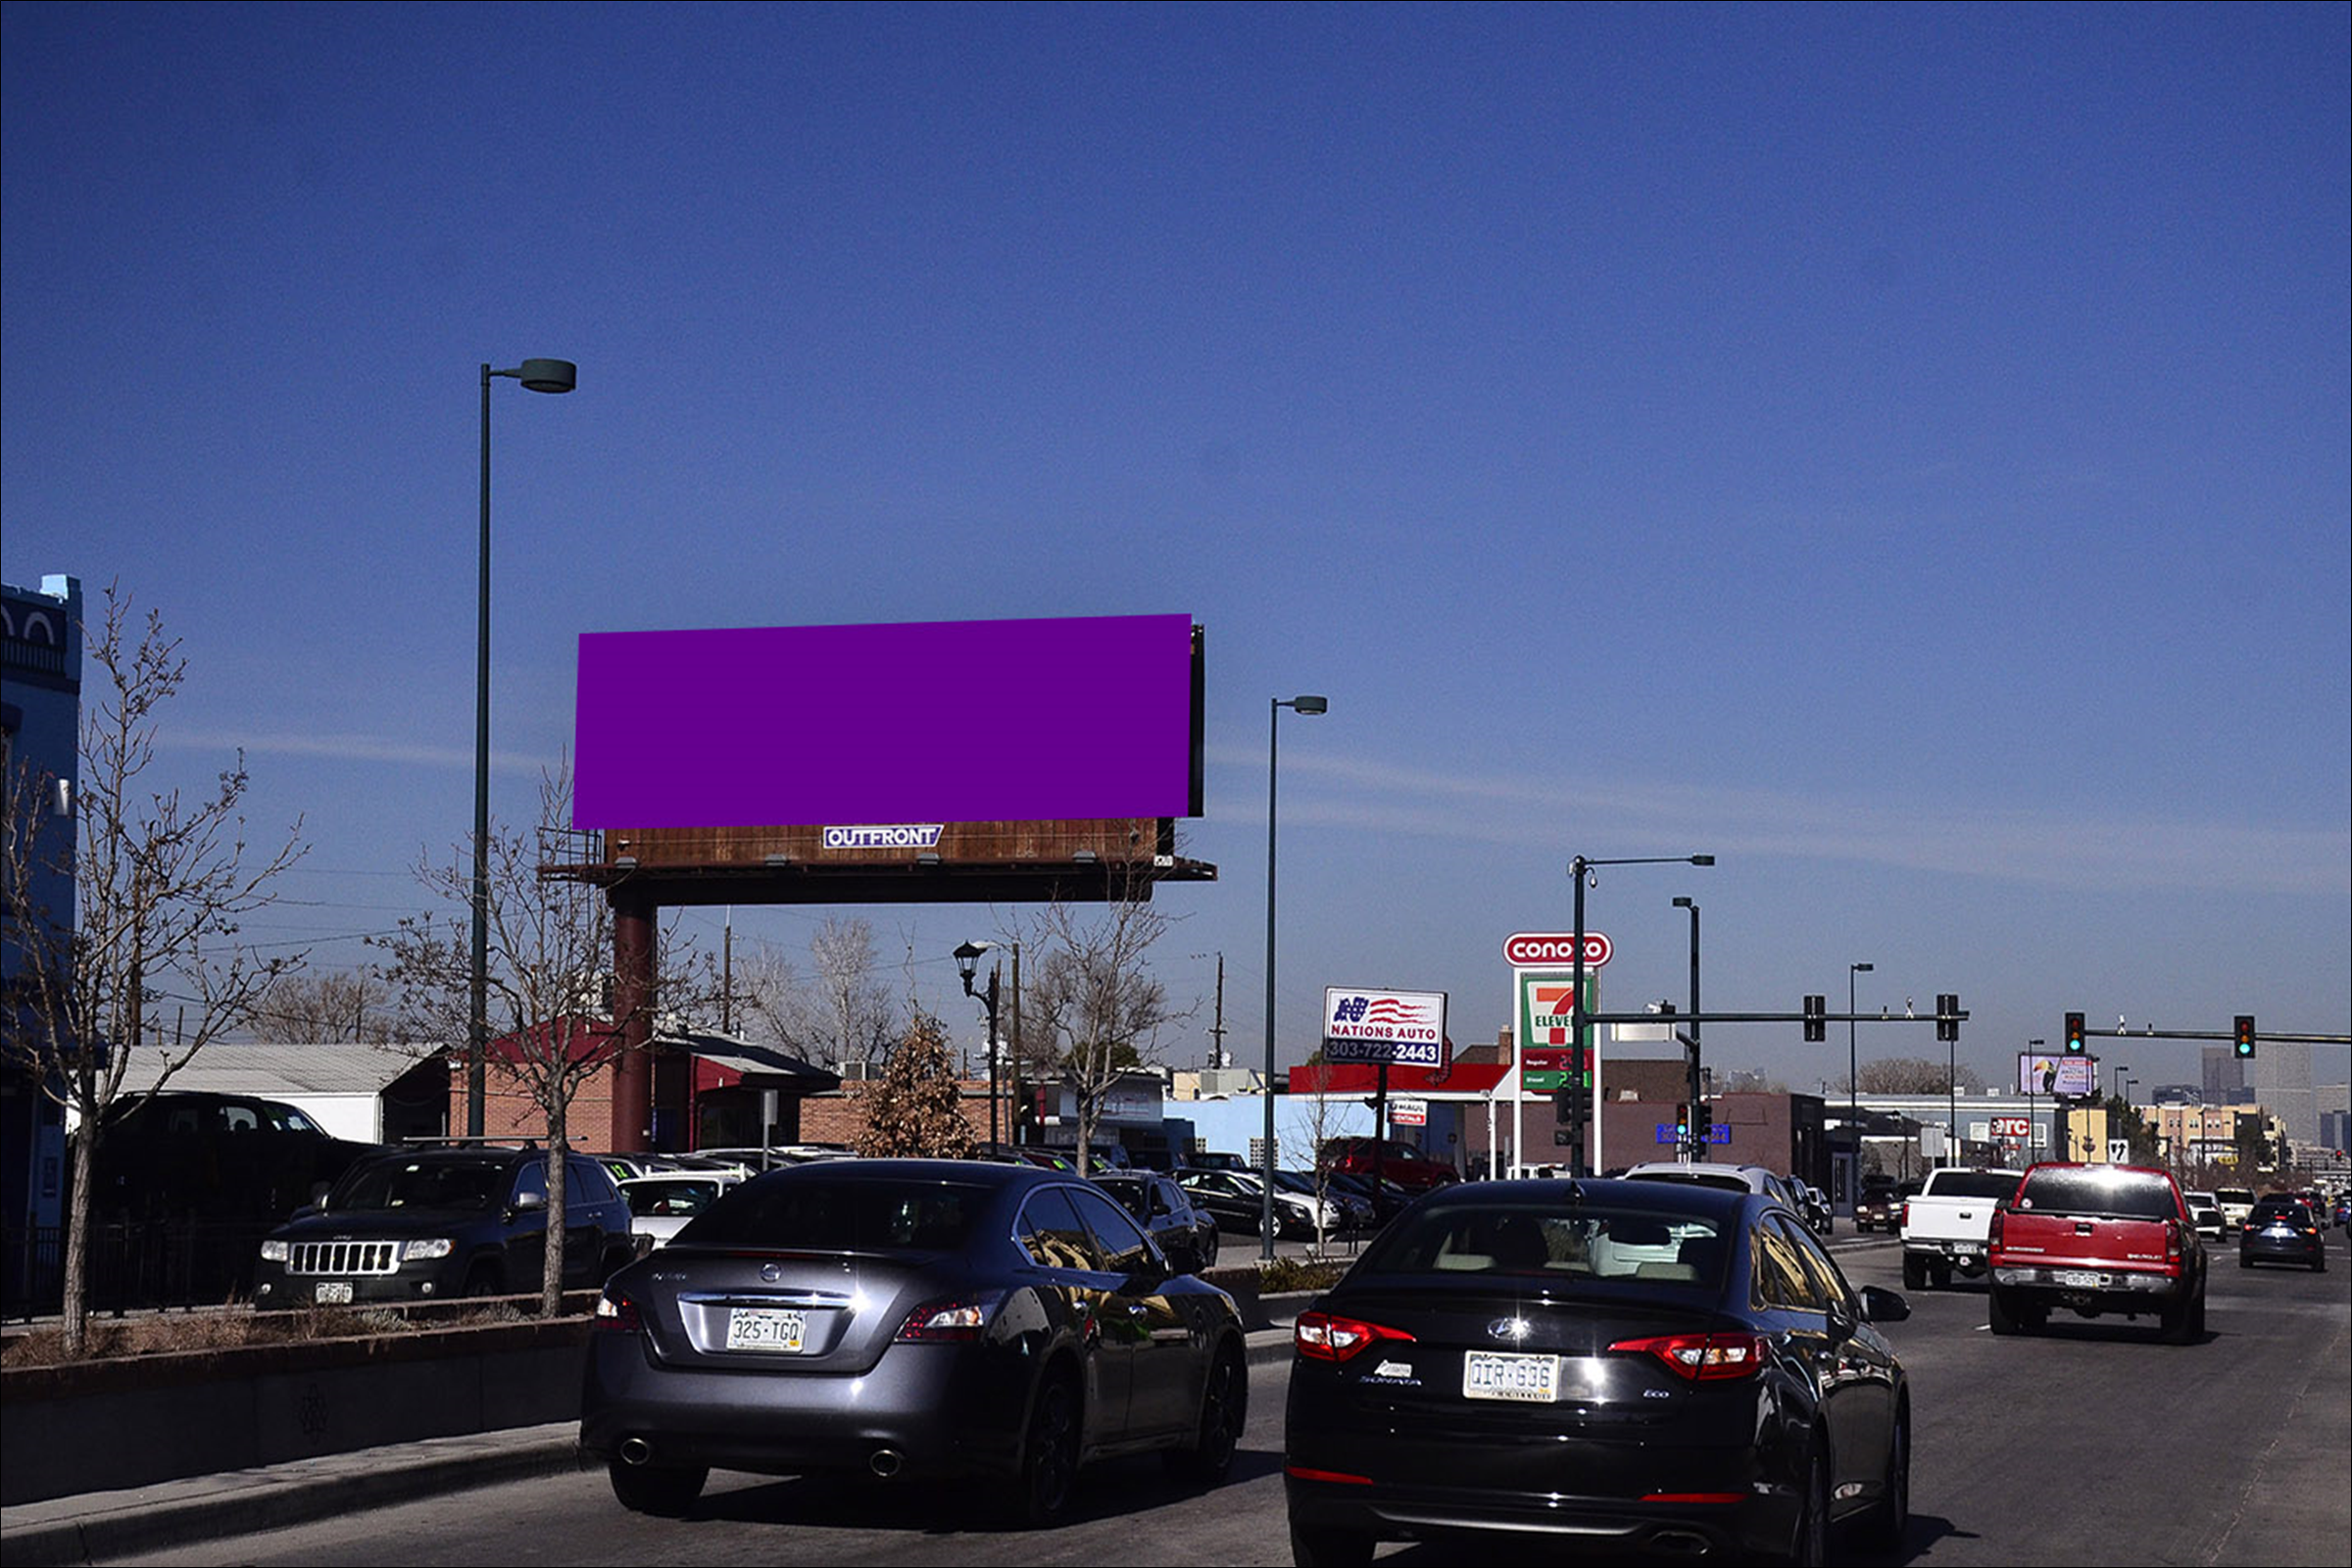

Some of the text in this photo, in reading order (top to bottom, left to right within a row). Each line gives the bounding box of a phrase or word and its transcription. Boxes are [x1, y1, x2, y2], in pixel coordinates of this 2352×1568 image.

[828, 828, 936, 845] OUTFRONT
[1512, 942, 1602, 957] conoo
[1535, 1015, 1576, 1027] ELEVE
[1331, 1024, 1436, 1040] NATIONS AUTO
[1328, 1041, 1437, 1062] 303-722-2443
